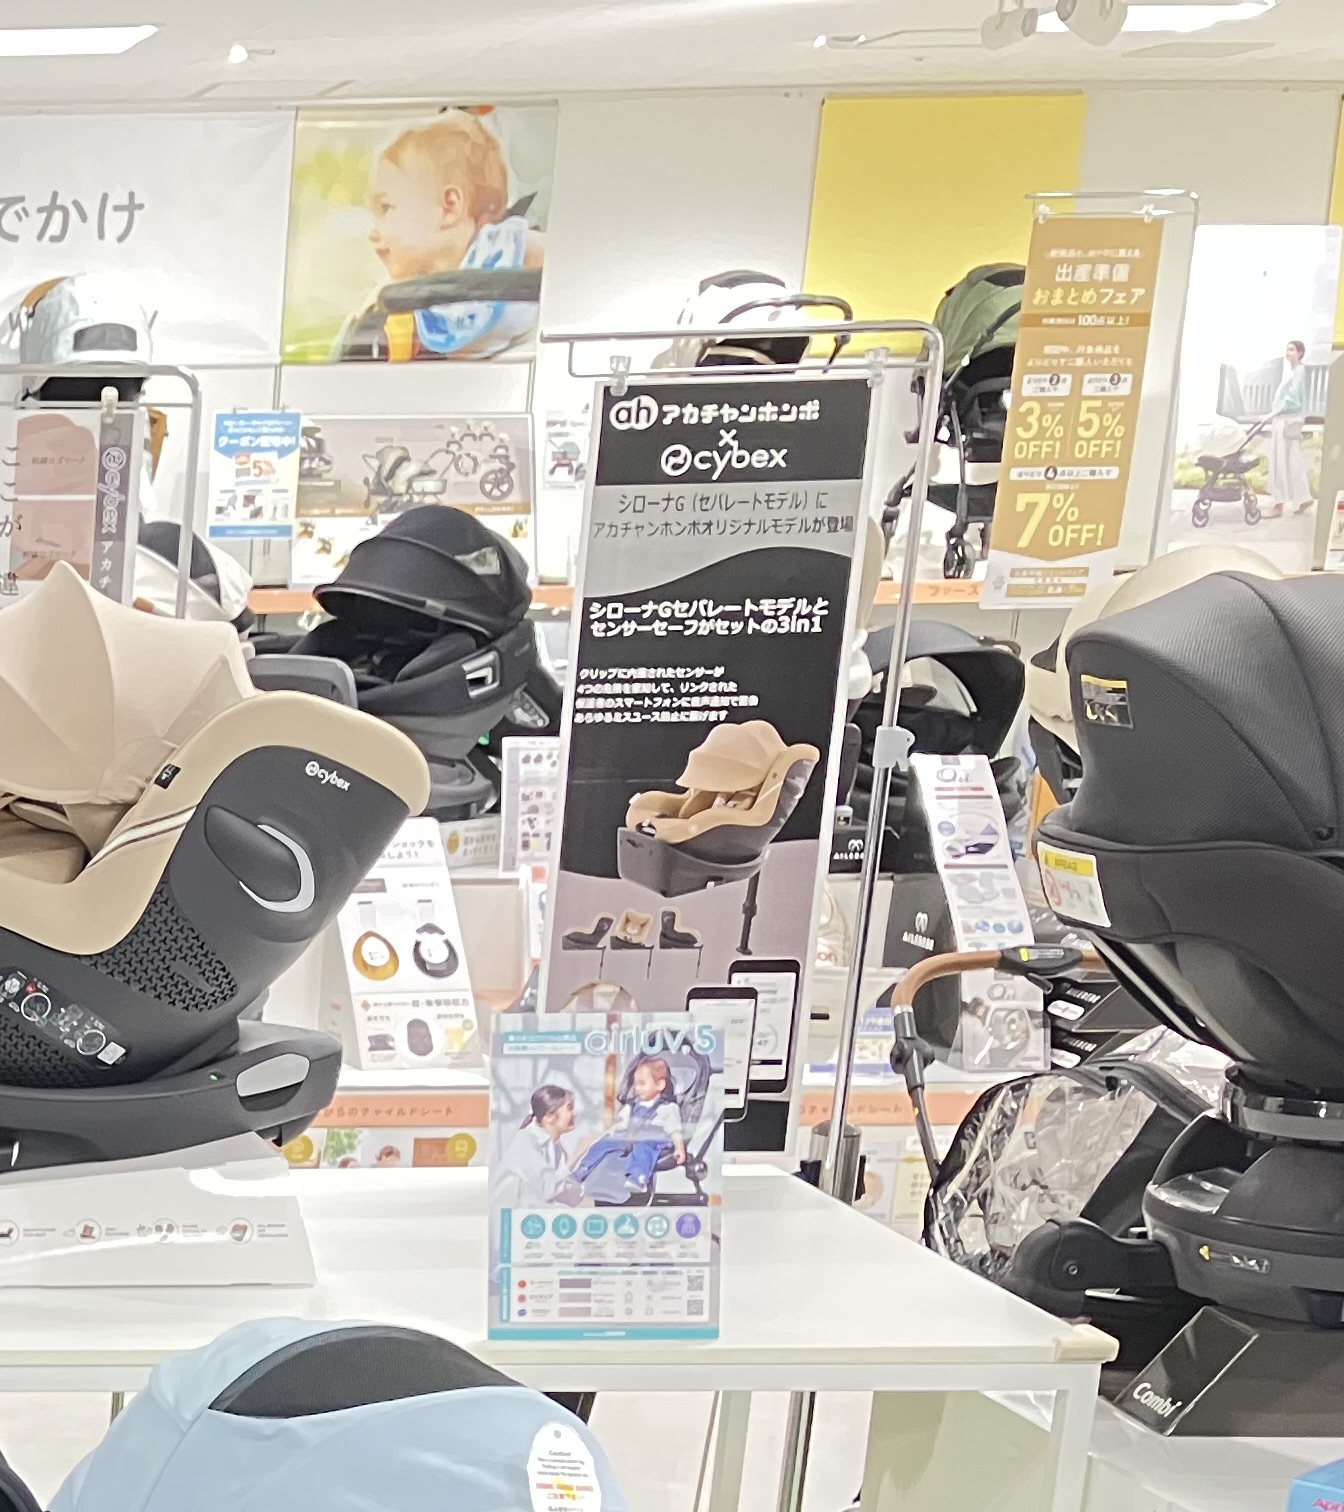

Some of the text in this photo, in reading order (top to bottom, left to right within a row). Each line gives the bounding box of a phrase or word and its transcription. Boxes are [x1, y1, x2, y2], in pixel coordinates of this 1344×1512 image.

[1032, 288, 1146, 306] おまとめフェア
[662, 400, 820, 425] アカチャンホンポ
[1016, 399, 1124, 439] 3% 5%
[693, 440, 788, 480] cybex
[1014, 440, 1122, 459] OFF! OFF!
[1048, 524, 1105, 548] OFF!
[589, 598, 829, 619] シローナGセパレートモデルと
[317, 767, 351, 793] cybex
[1132, 1381, 1182, 1419] Combi
